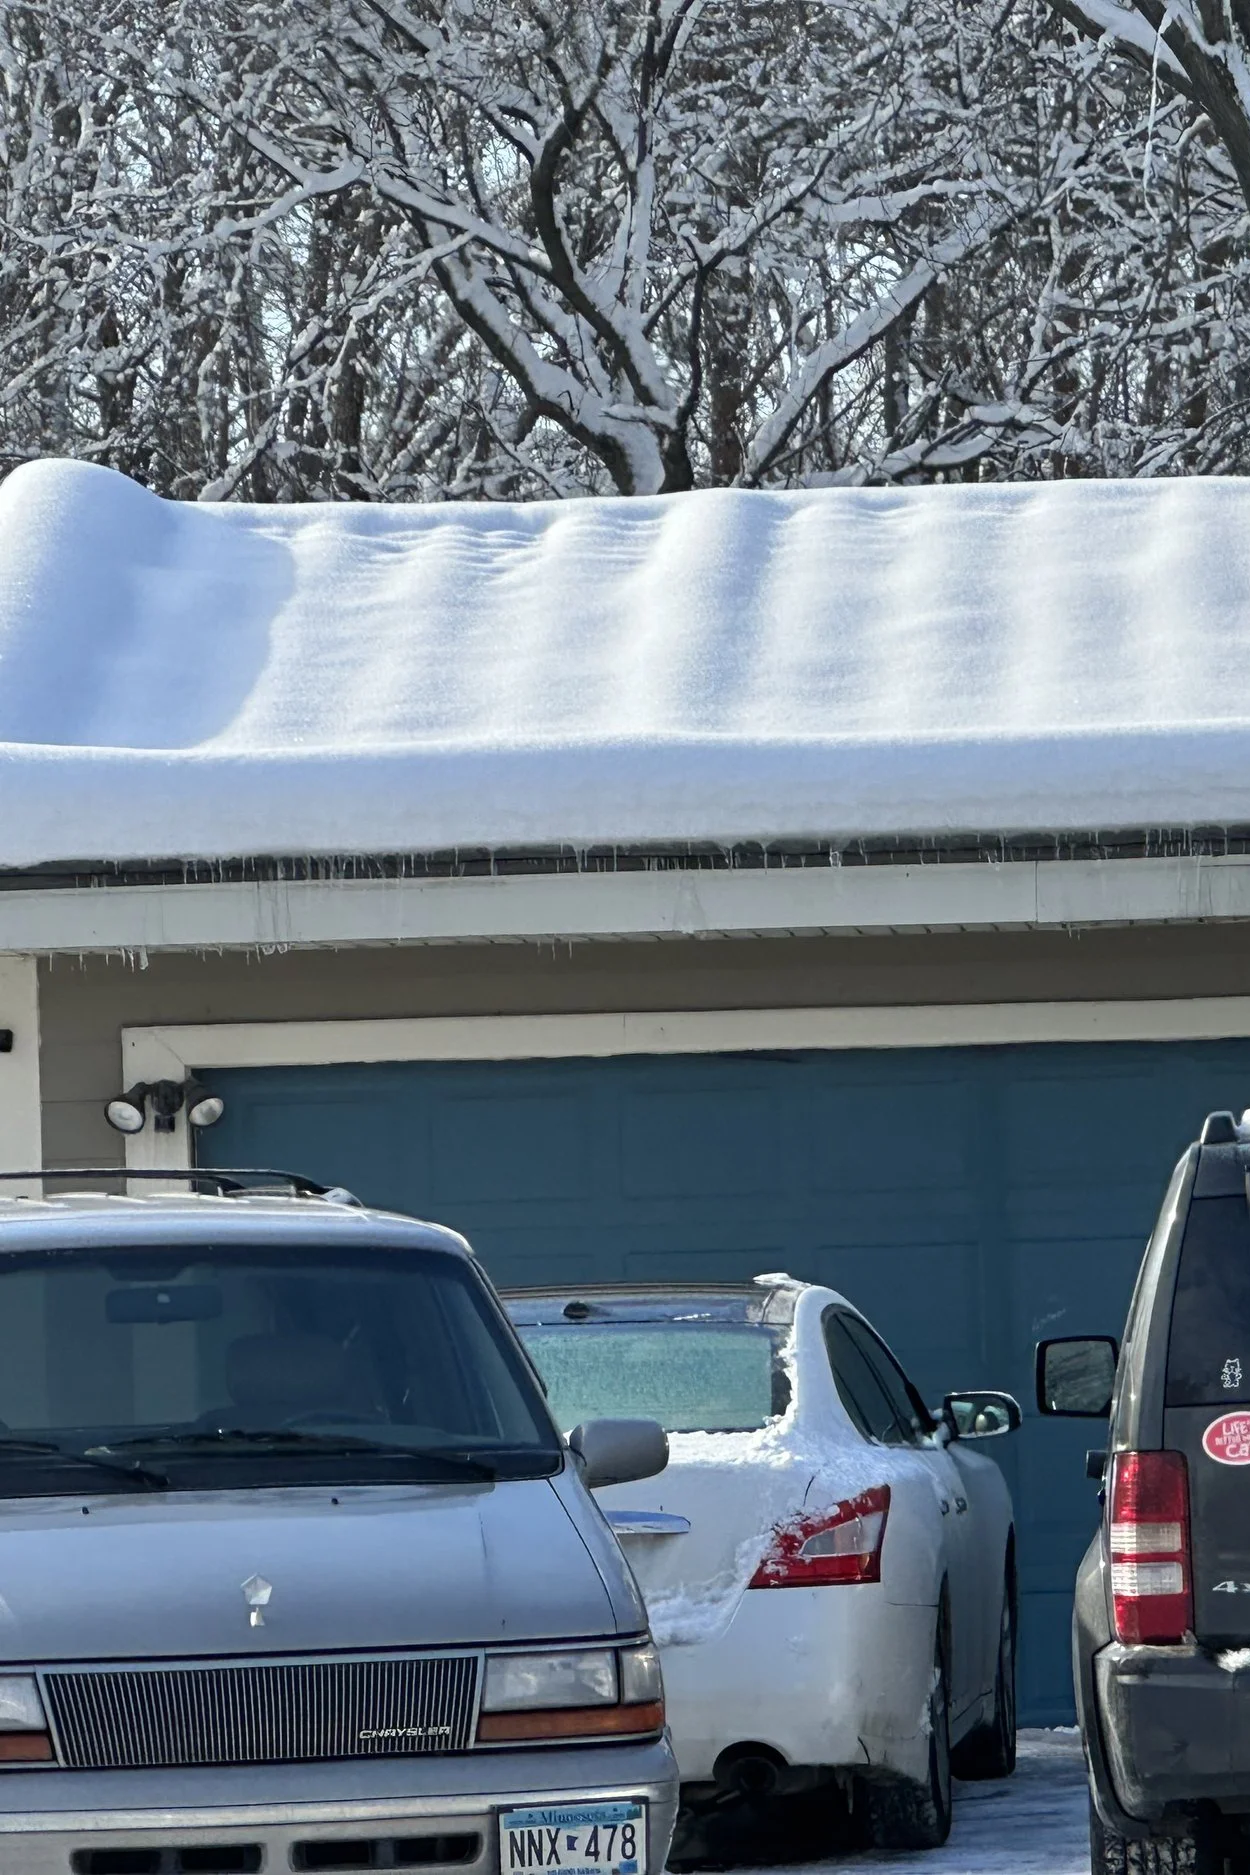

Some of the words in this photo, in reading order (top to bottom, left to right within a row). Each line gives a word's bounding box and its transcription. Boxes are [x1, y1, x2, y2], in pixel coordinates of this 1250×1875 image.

[359, 1726, 451, 1739] CHRYSLER
[541, 1808, 606, 1824] Minnesota
[509, 1827, 561, 1868] NNX
[584, 1823, 637, 1863] 478
